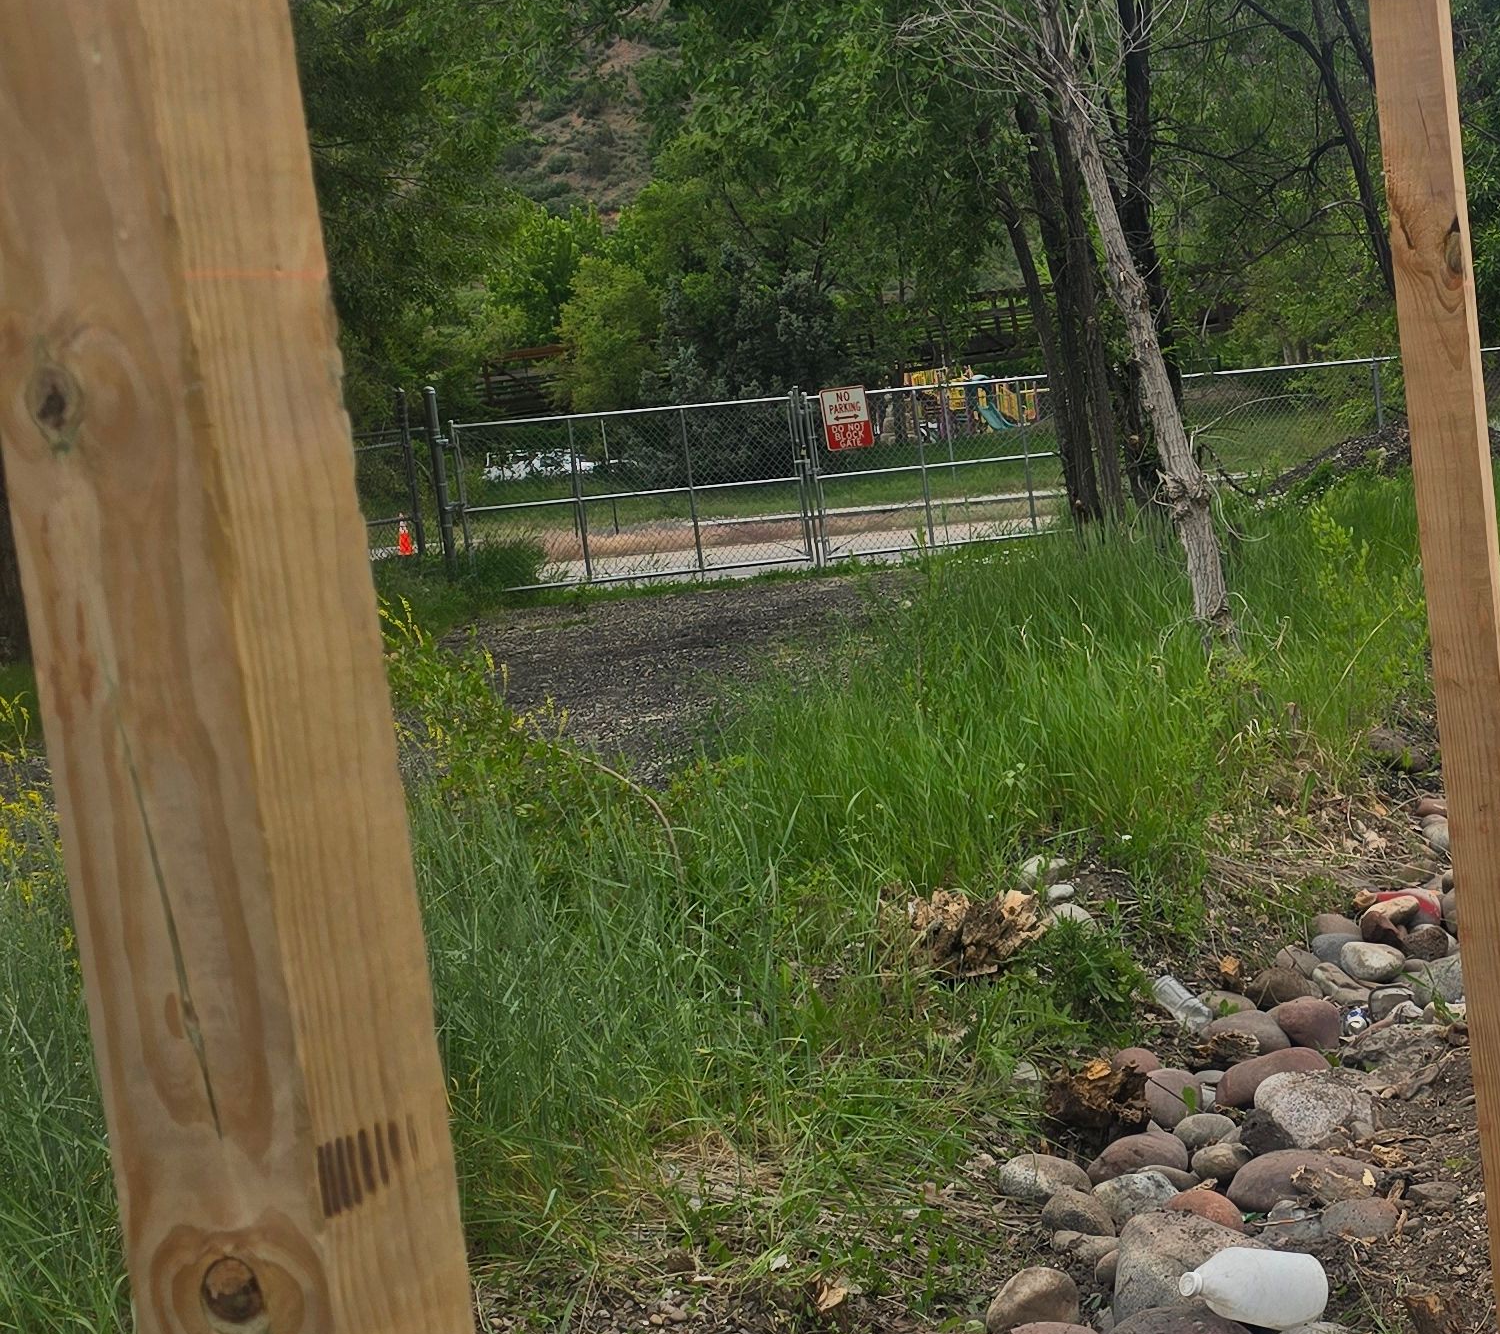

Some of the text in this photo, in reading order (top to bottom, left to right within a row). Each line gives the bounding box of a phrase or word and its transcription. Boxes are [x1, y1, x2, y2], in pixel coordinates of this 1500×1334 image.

[835, 391, 850, 402] NO
[828, 402, 861, 415] PARKING
[831, 422, 865, 434] DO NOT
[834, 430, 865, 441] BLOCK
[840, 437, 863, 448] GATE
